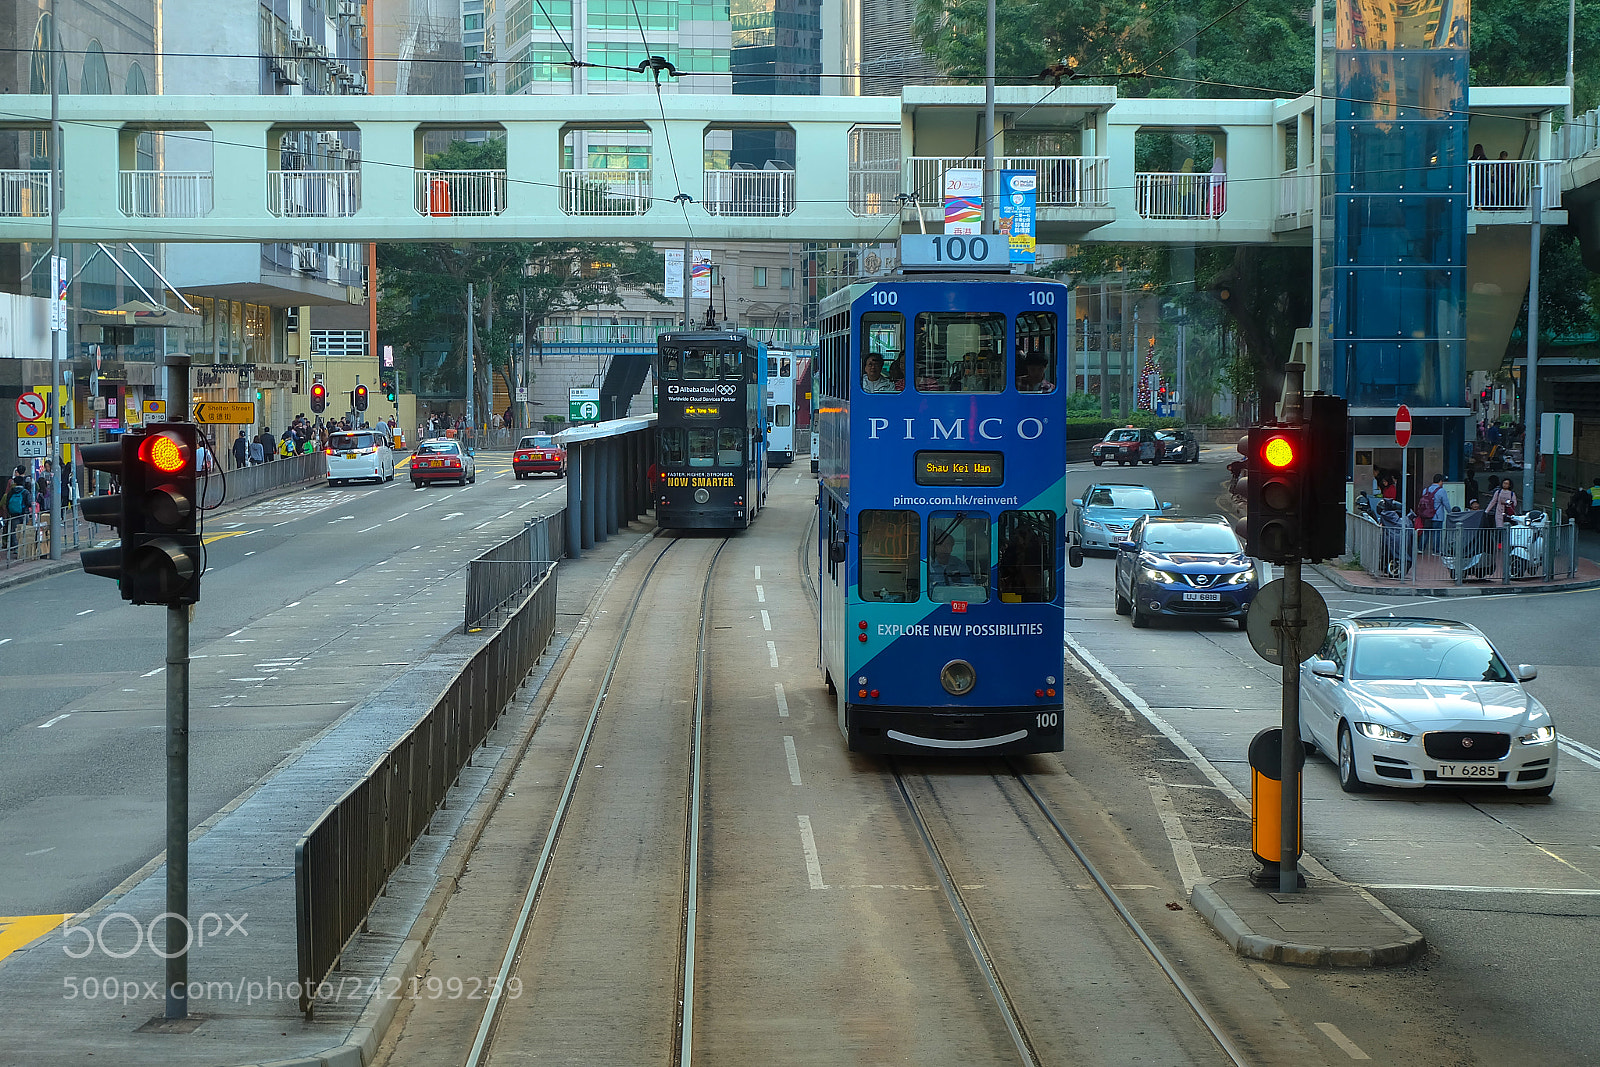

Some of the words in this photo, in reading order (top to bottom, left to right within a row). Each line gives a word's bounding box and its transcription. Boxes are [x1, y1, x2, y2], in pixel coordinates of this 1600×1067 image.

[947, 181, 962, 190] 20
[932, 236, 989, 262] 100
[871, 291, 898, 306] 100
[1028, 290, 1055, 306] 100
[700, 385, 715, 393] Cloud
[23, 447, 41, 455] 全日
[926, 462, 949, 473] Shau
[953, 463, 969, 473] Kei
[974, 463, 991, 473] Wan
[667, 477, 689, 487] NOW
[691, 477, 736, 487] SMARTER.
[893, 494, 1018, 506] pimco.com.hk/reinvent
[953, 602, 966, 611] 029
[877, 624, 930, 636] EXPLORE
[933, 624, 962, 636] NEW
[965, 623, 1043, 636] POSSIBILITIES
[1035, 713, 1058, 728] 100
[1440, 765, 1456, 775] TY
[1461, 765, 1496, 776] 6285
